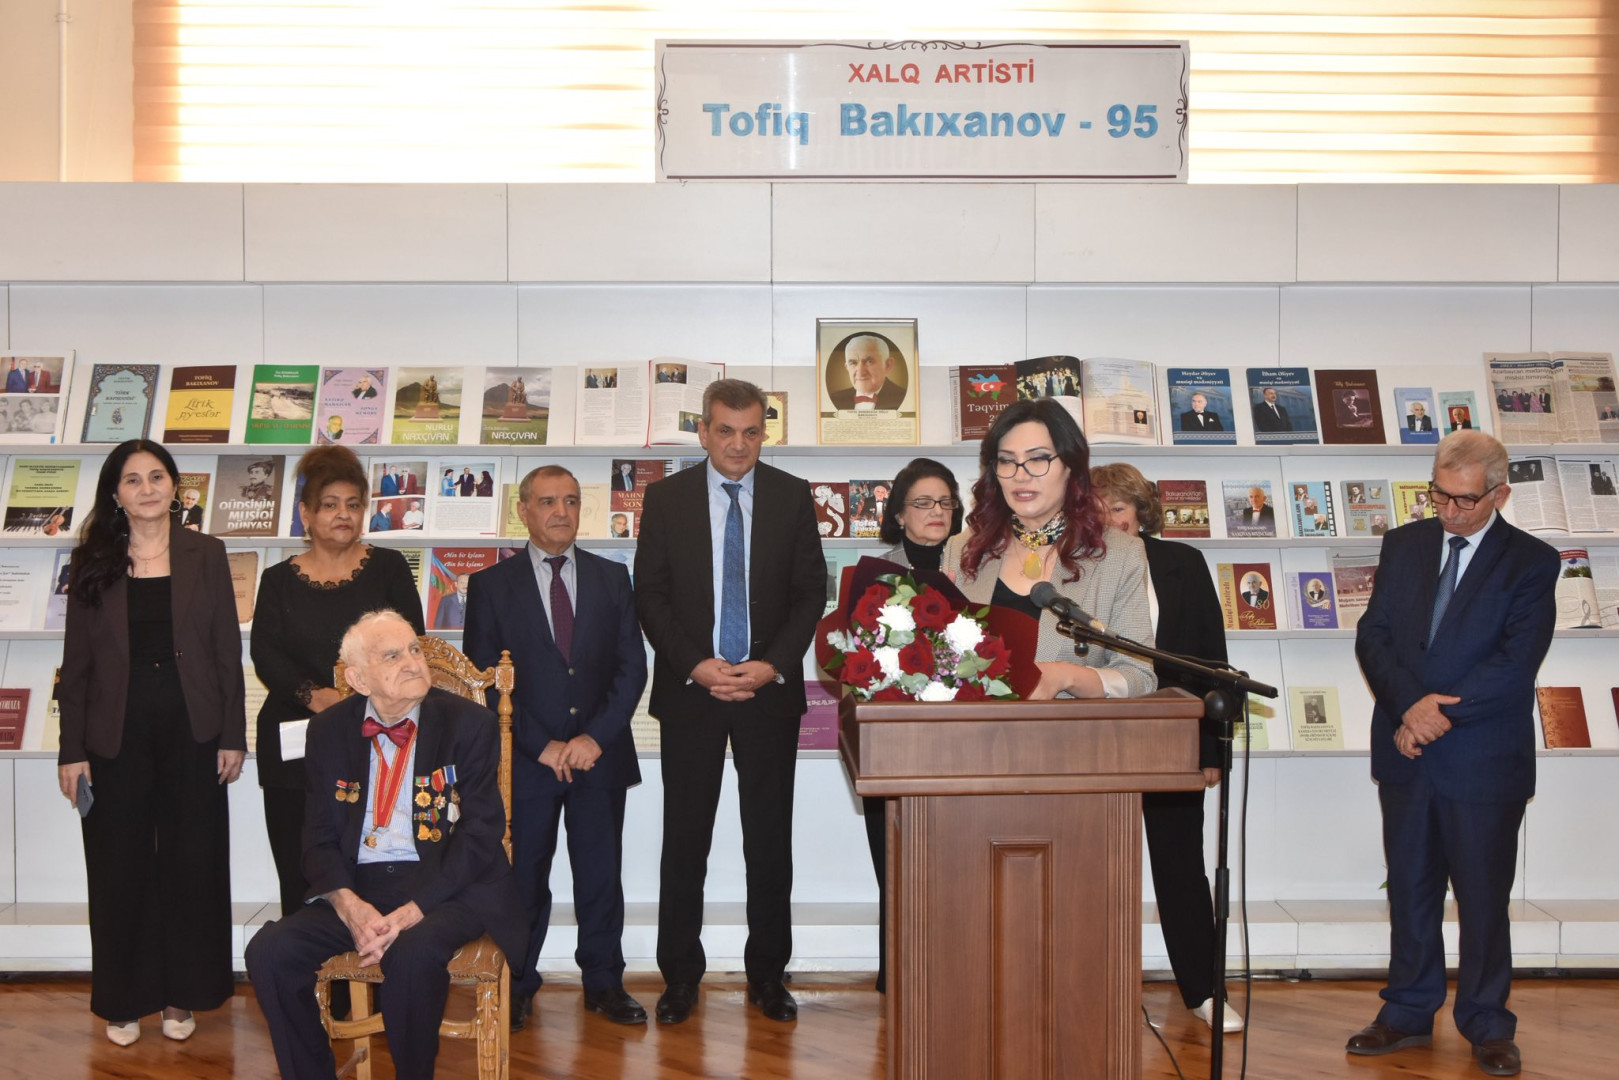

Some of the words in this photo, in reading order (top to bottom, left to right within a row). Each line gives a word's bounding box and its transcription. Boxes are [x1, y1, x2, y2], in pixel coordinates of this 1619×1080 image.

[848, 63, 920, 86] XALQ
[934, 58, 1035, 84] ARTİSTİ
[702, 103, 810, 146] Tofiq
[840, 103, 1066, 138] Bakıxanov
[1107, 104, 1159, 139] 95
[402, 432, 450, 443] NAXÇIVAN
[491, 431, 538, 442] NAXÇIVAN
